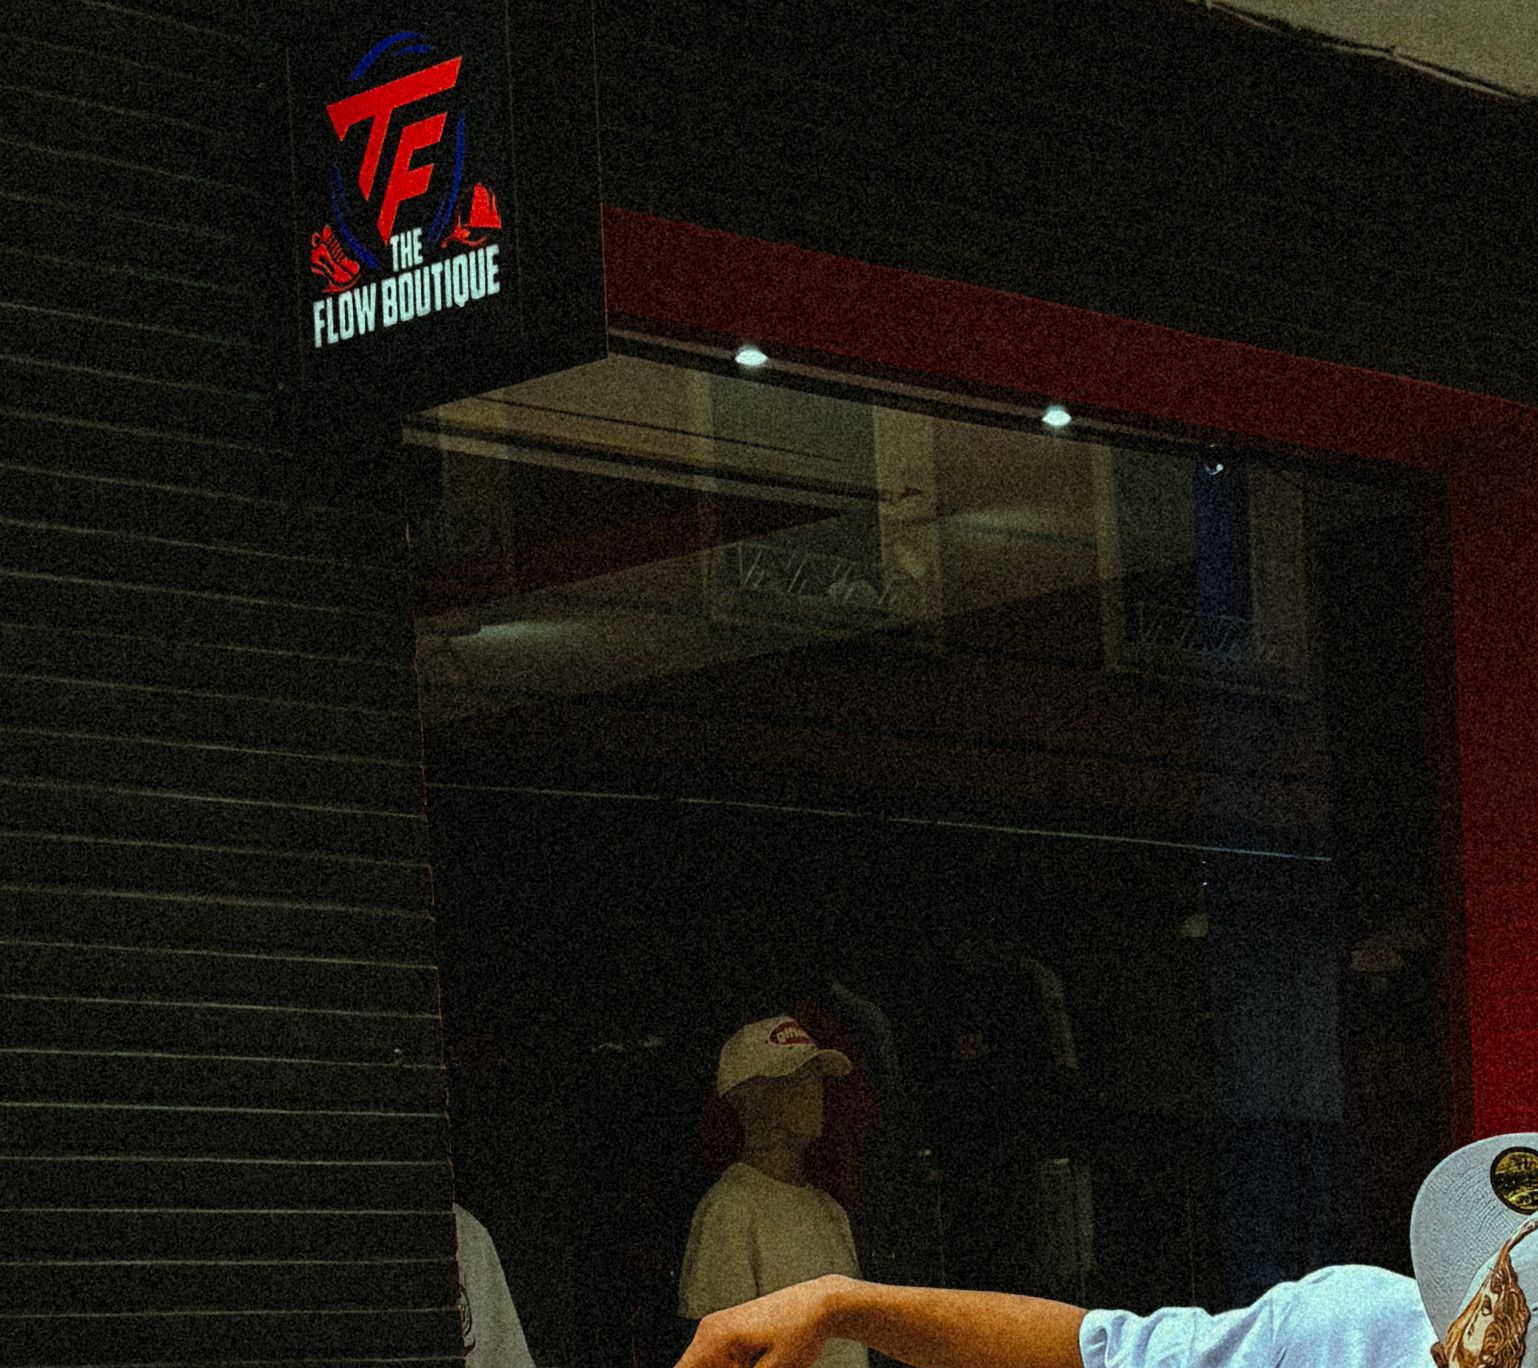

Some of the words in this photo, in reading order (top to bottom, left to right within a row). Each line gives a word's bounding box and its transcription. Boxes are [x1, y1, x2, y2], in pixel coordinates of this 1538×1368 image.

[390, 227, 423, 272] THE
[313, 282, 377, 348] FLOW
[381, 244, 500, 327] BOUTIQUE
